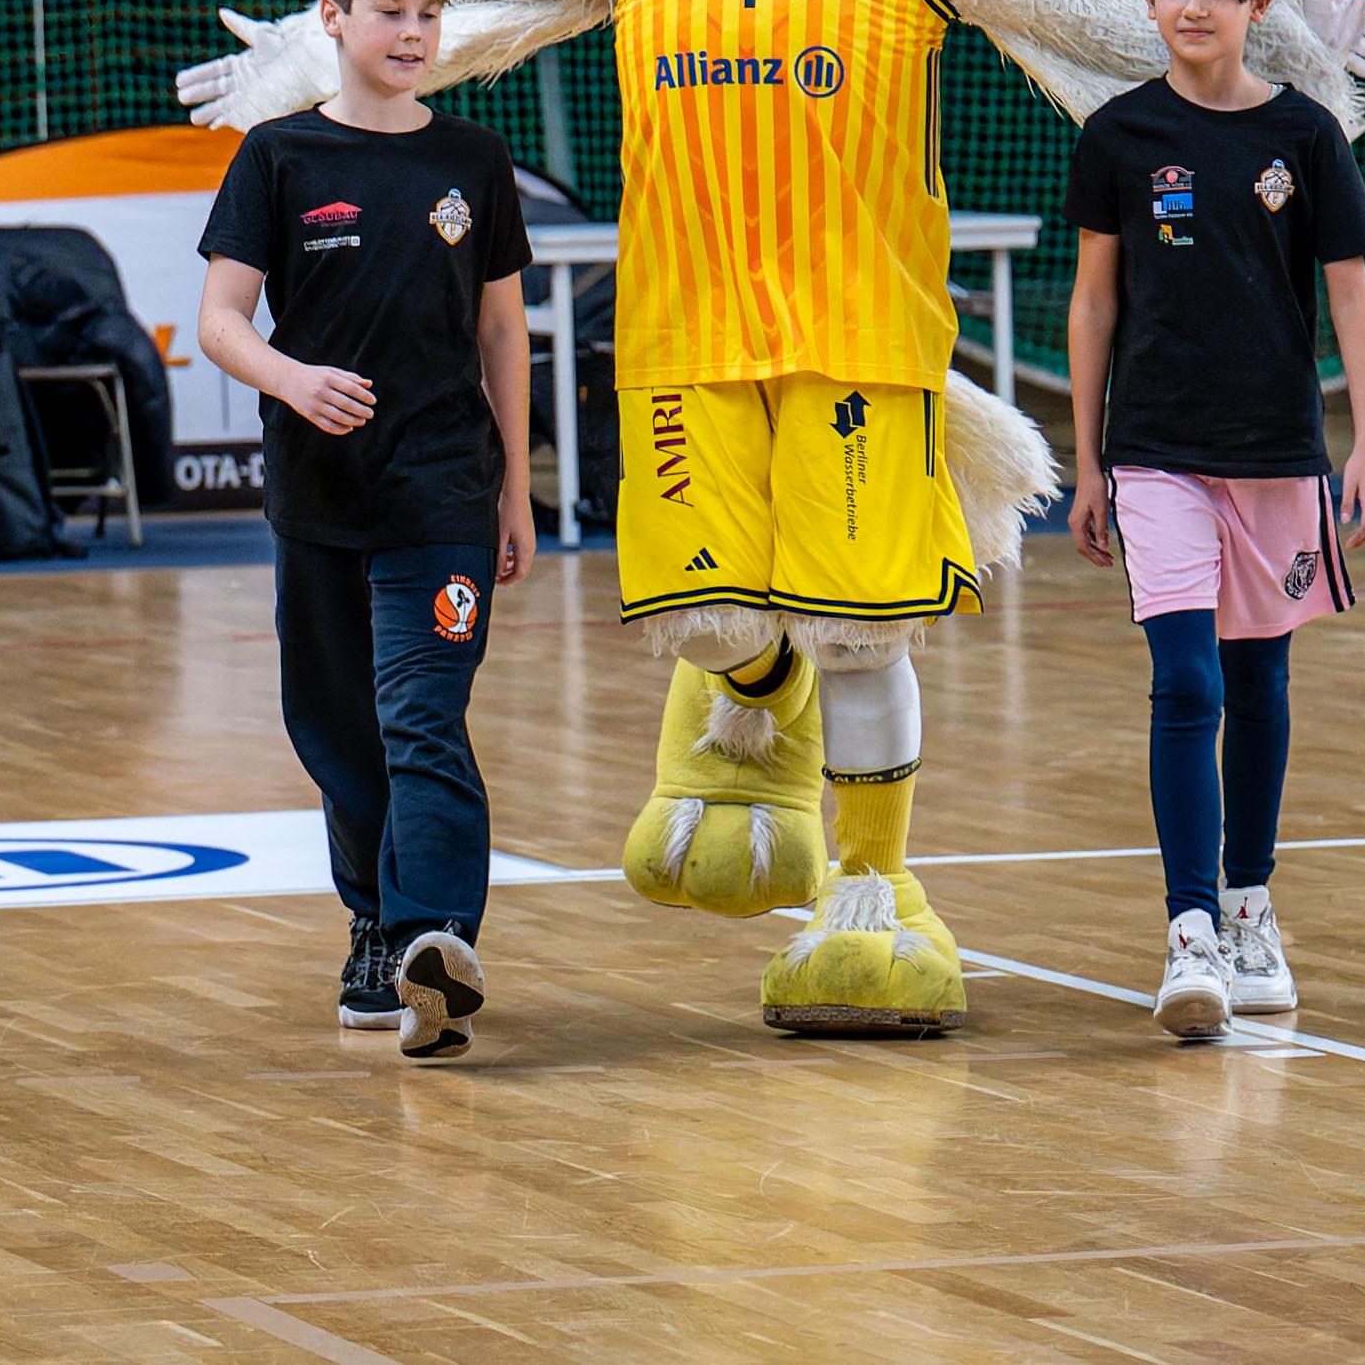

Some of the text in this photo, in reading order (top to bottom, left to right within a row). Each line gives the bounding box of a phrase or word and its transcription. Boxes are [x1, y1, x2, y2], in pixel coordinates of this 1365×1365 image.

[654, 50, 784, 92] Allianz
[651, 387, 695, 508] AMRI
[856, 434, 868, 485] Berliner
[843, 443, 857, 541] Wasserbetriebe
